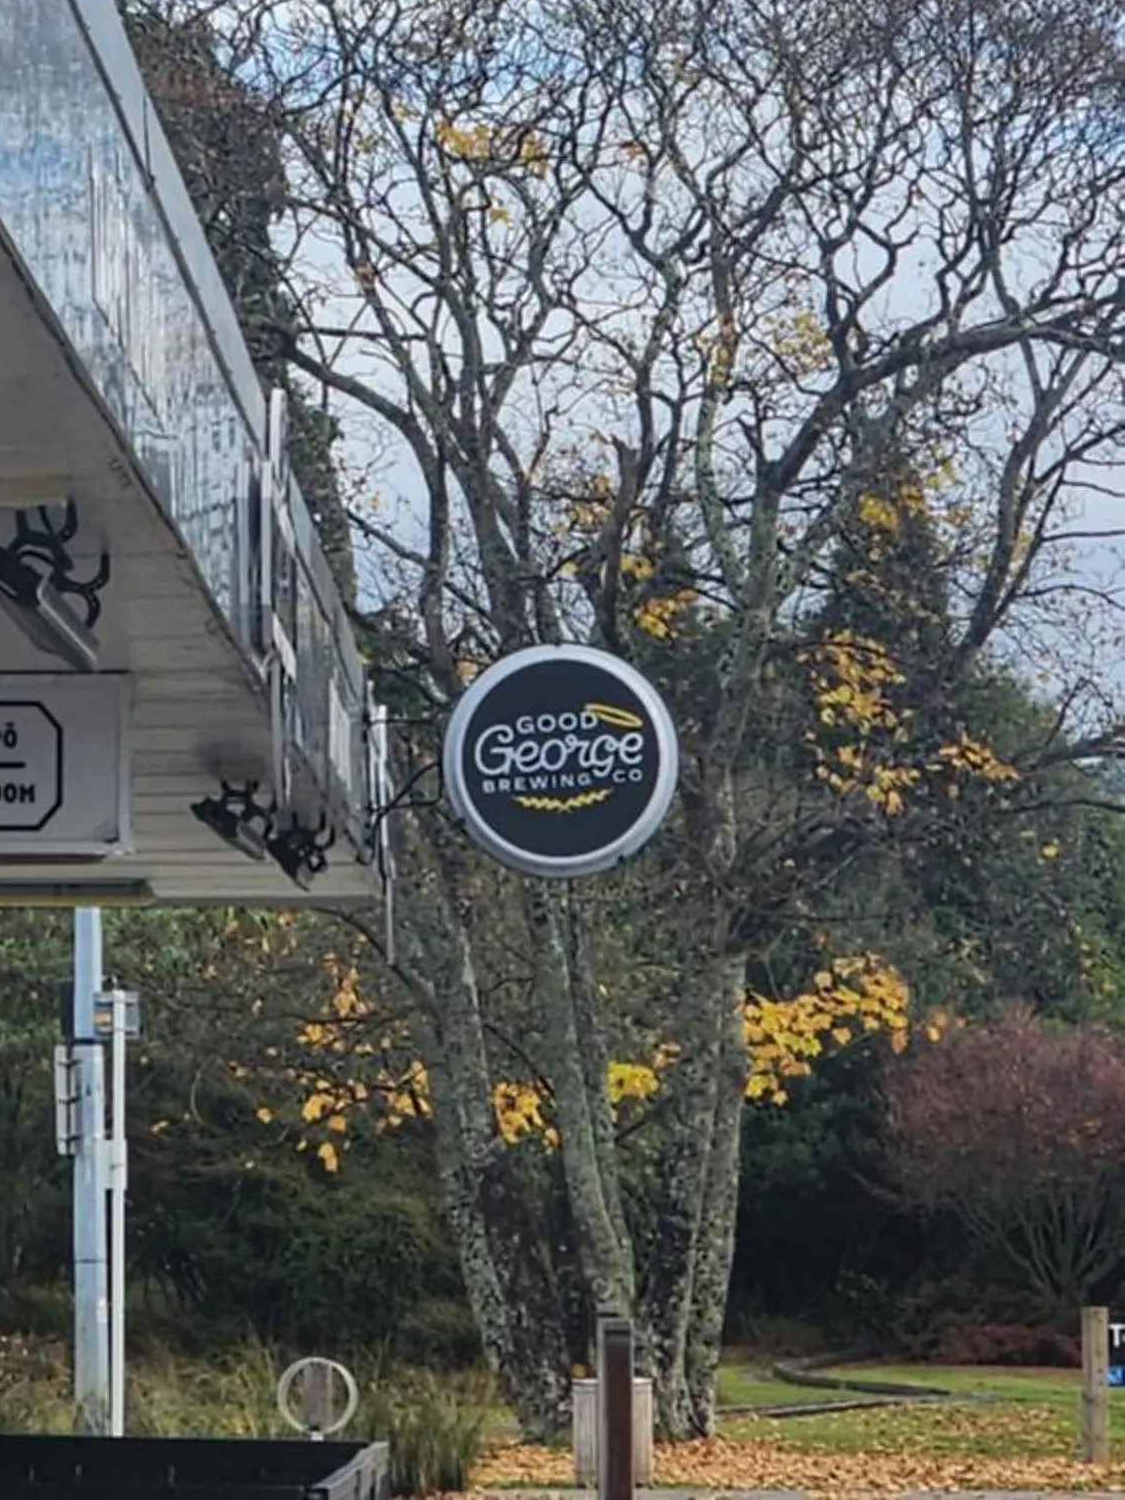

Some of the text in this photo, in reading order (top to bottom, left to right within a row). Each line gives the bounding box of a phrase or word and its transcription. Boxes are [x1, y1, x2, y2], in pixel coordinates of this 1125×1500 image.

[516, 712, 599, 734] GOOD
[475, 724, 644, 777] George
[482, 768, 644, 794] BREWING CO
